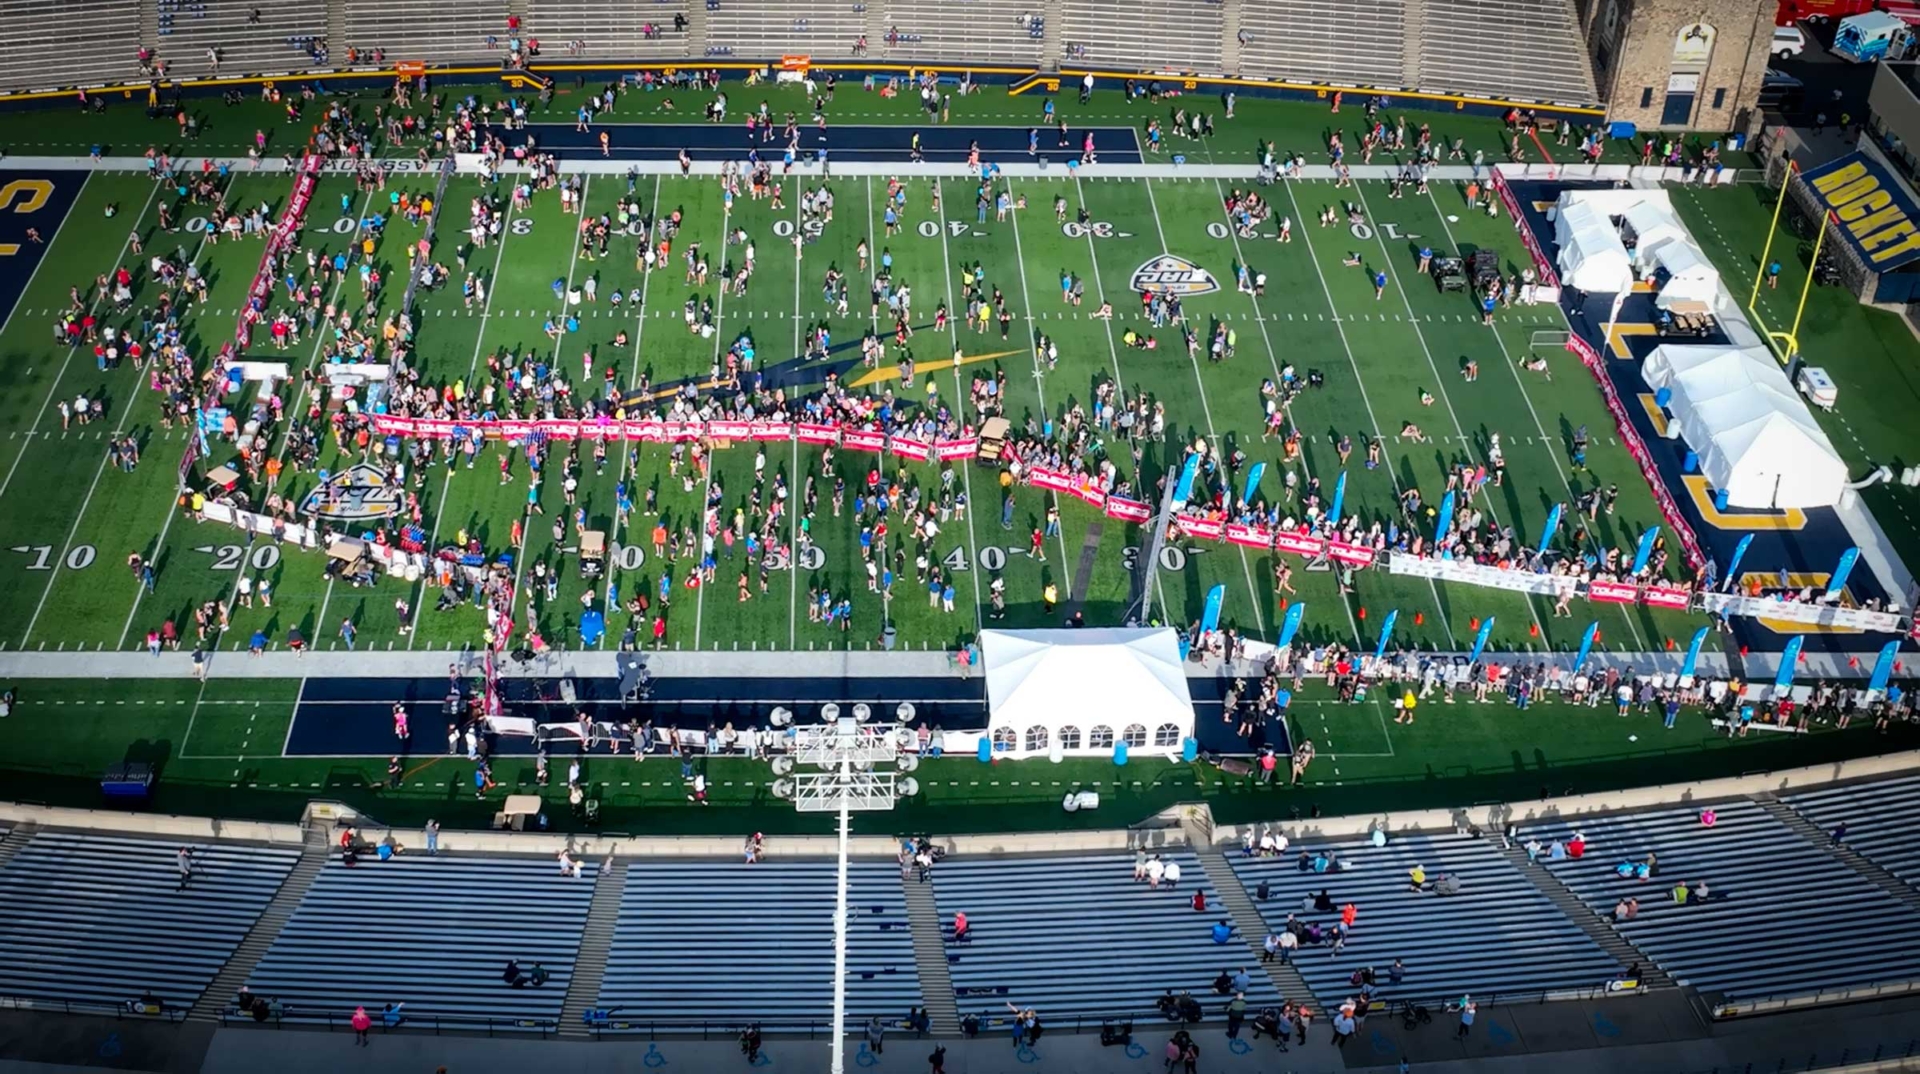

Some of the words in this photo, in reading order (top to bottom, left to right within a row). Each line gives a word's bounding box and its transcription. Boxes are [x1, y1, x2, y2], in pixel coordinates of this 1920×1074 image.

[1184, 80, 1197, 90] 20
[1811, 160, 1920, 264] ROCKET
[918, 219, 969, 238] 40
[1350, 222, 1405, 240] 10
[25, 544, 97, 570] 10
[210, 544, 282, 570] 20
[943, 546, 1006, 570] 40
